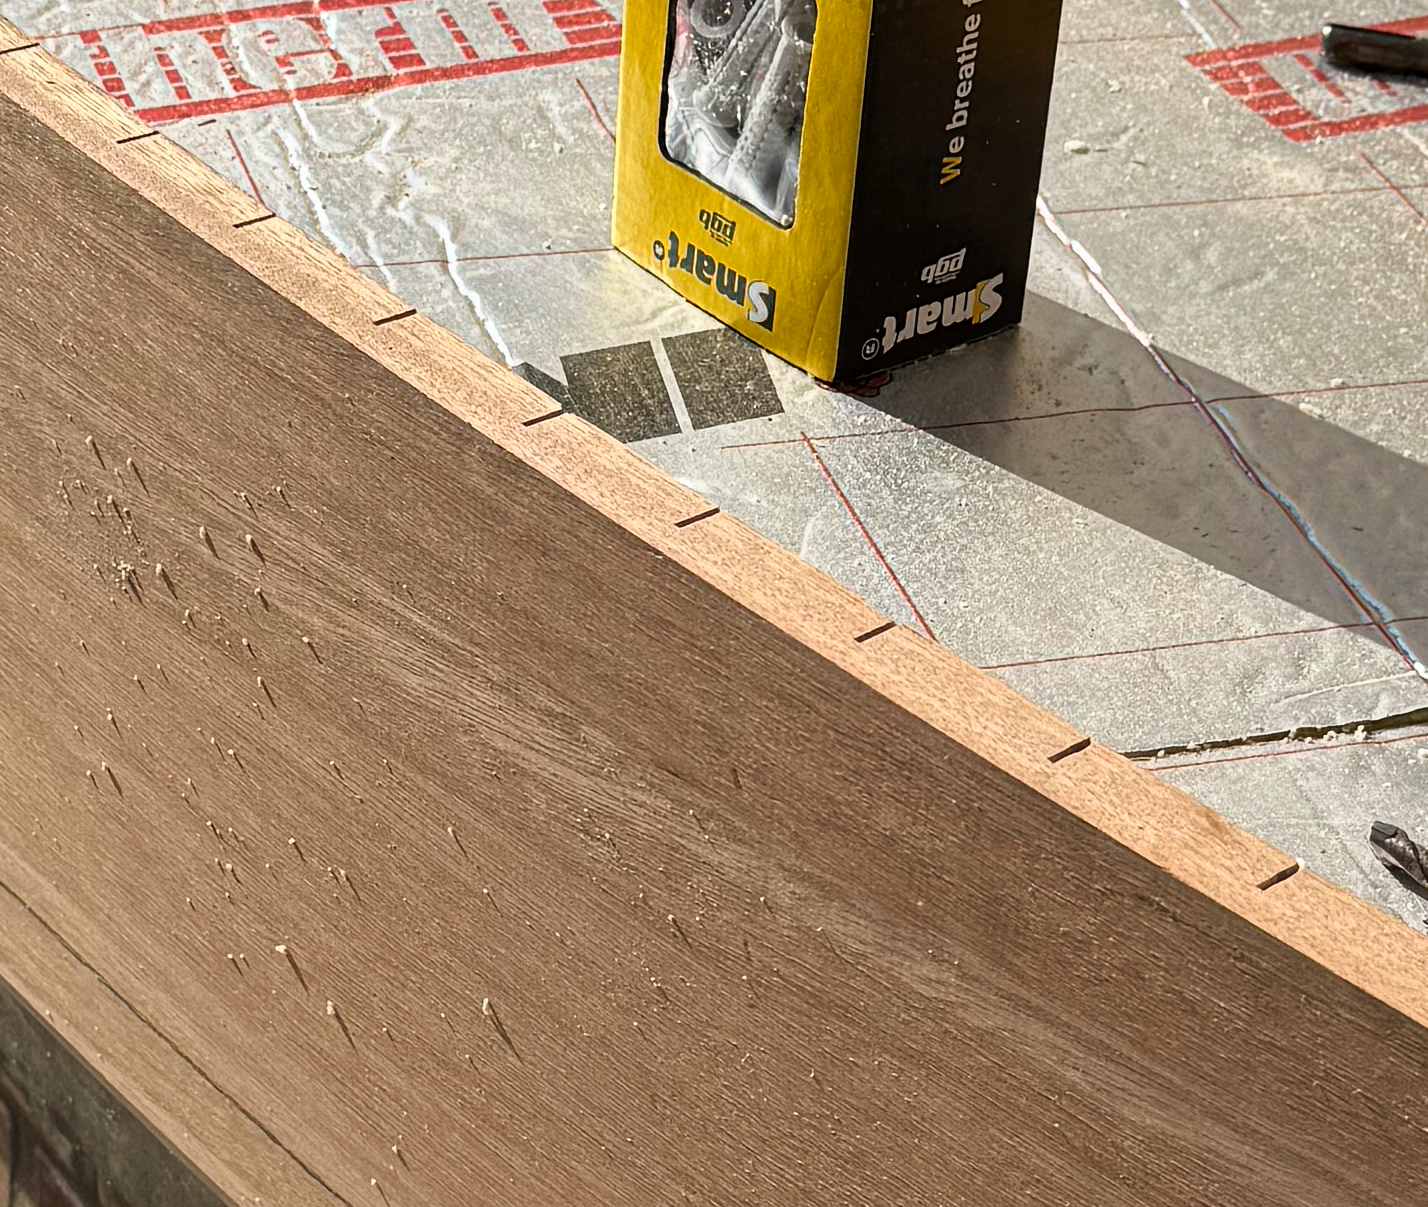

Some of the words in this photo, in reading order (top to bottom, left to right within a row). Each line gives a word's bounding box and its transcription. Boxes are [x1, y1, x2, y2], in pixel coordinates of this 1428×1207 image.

[946, 12, 982, 131] breathe
[940, 134, 965, 185] We
[699, 208, 737, 242] pgb
[921, 247, 967, 280] pgb
